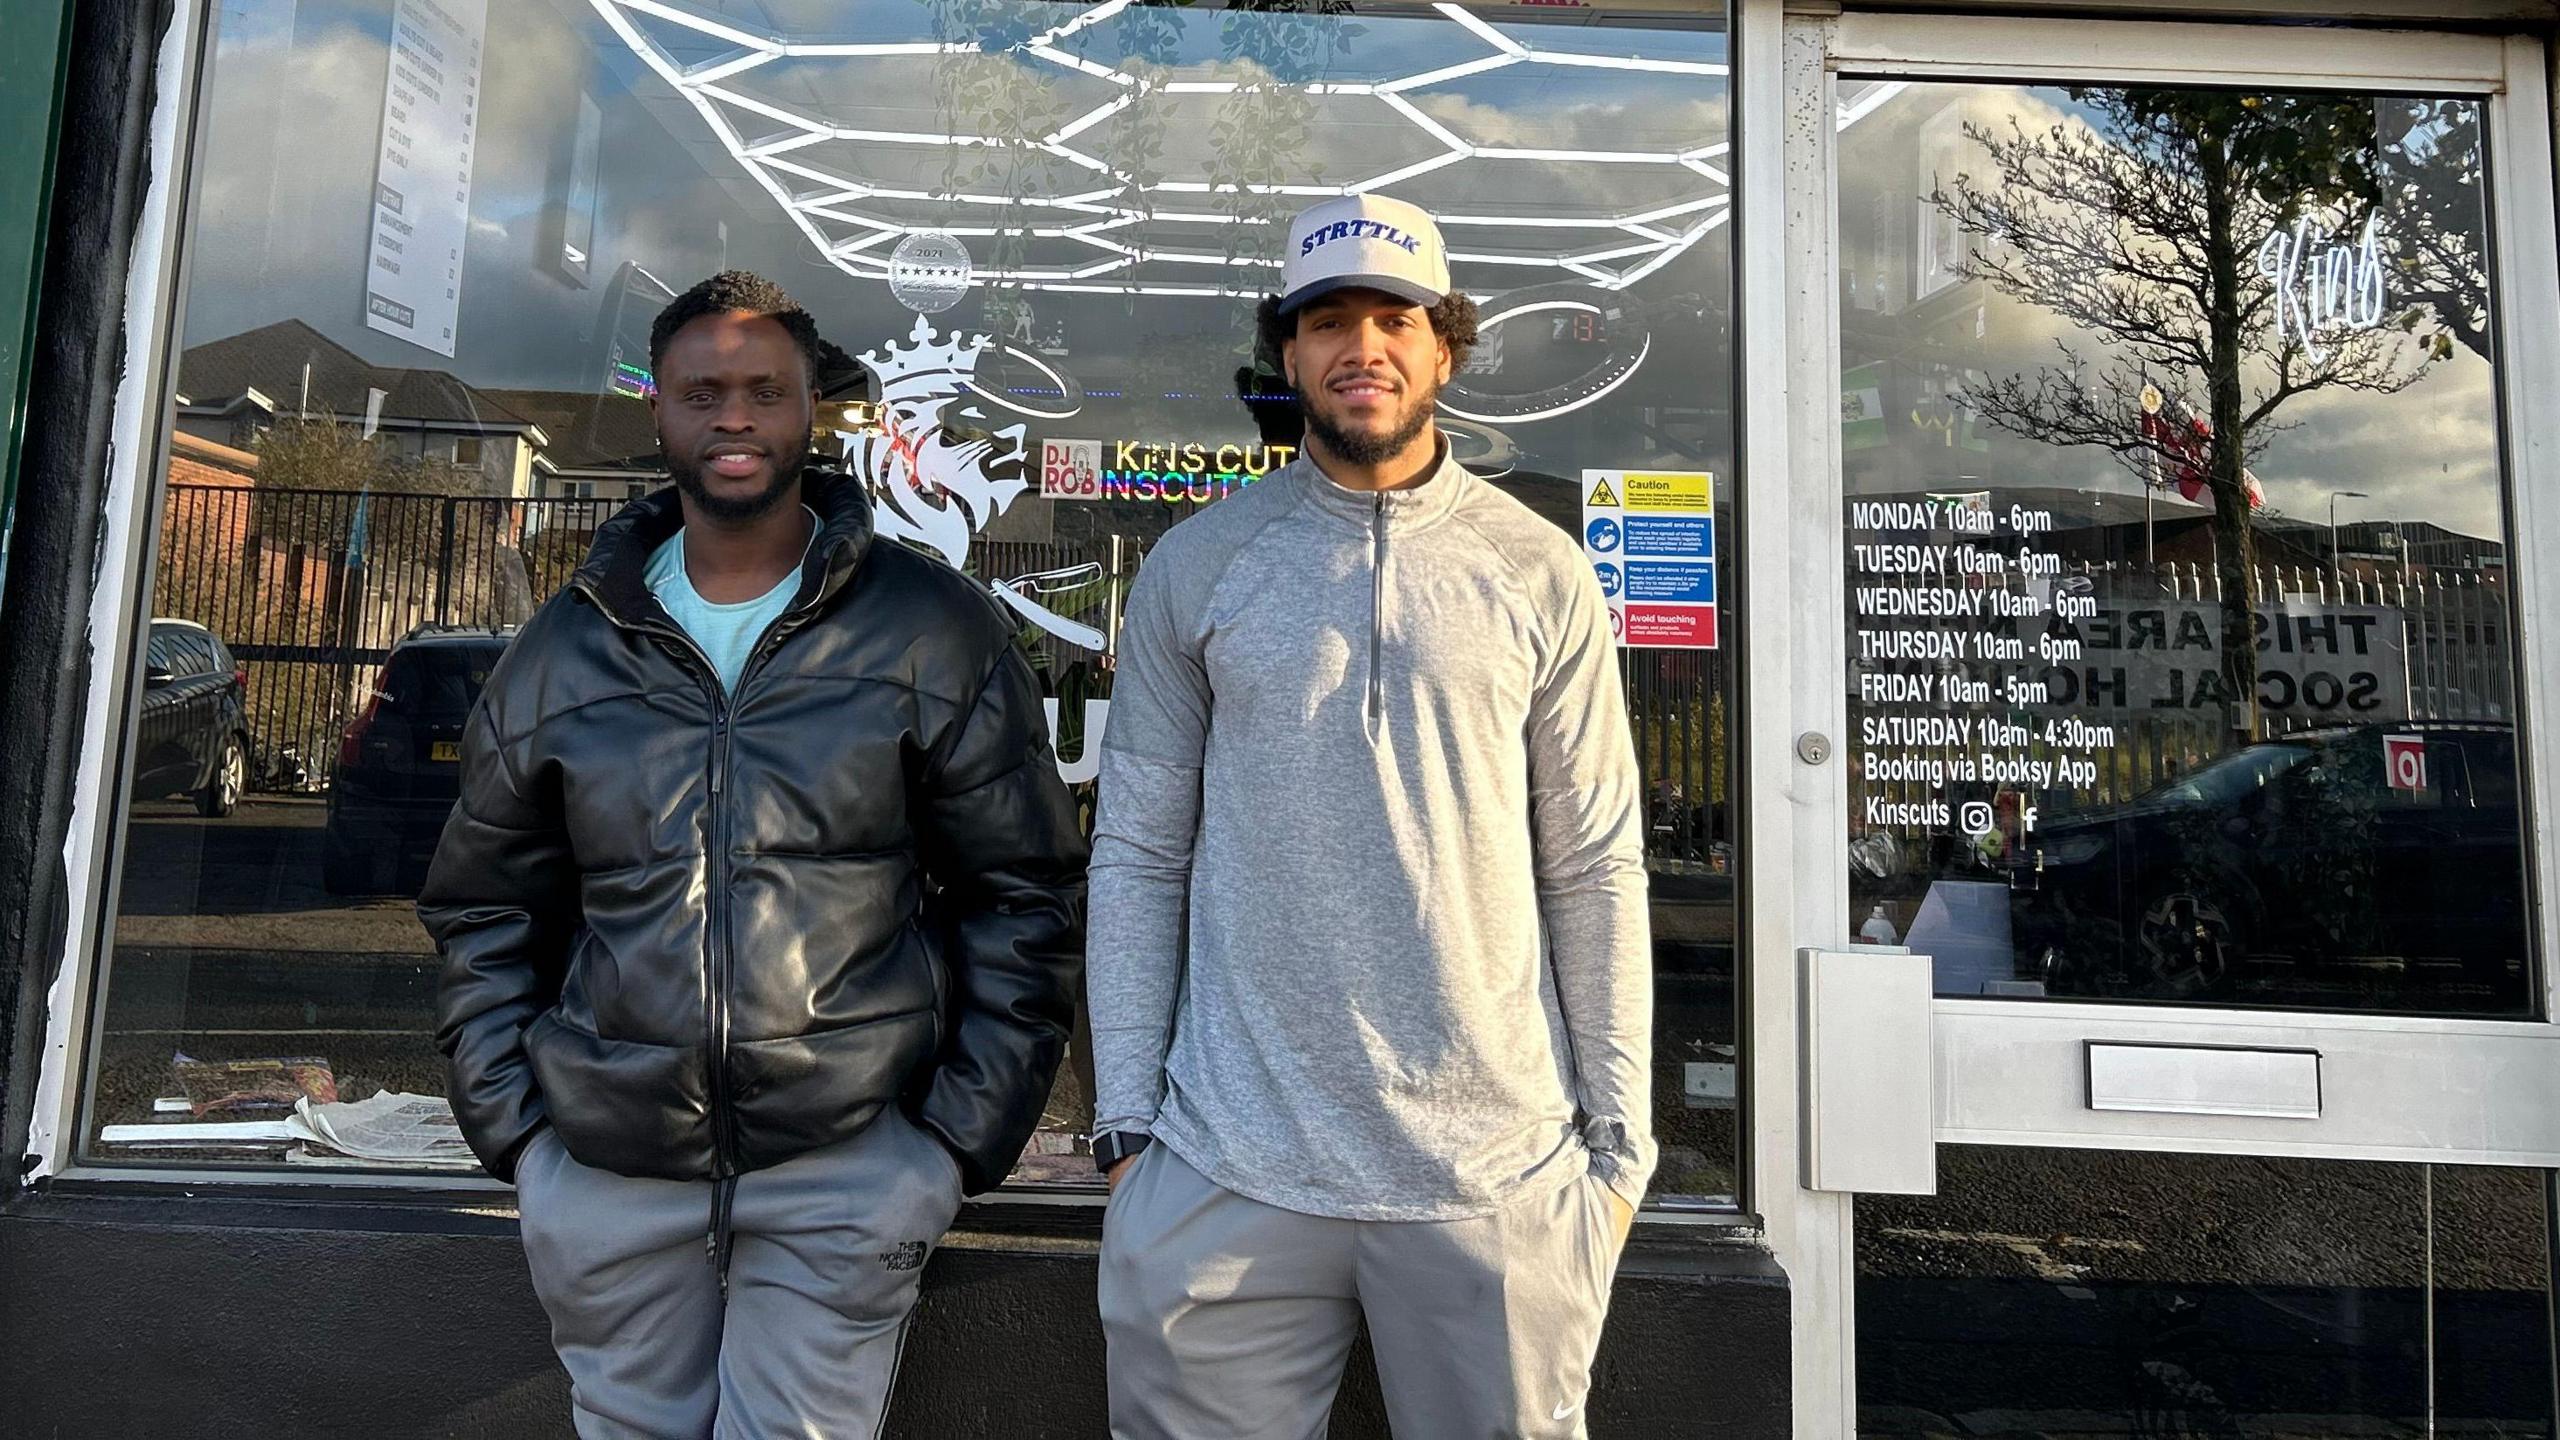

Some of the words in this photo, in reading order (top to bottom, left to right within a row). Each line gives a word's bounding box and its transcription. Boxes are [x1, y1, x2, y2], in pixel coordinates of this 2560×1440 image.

[916, 249, 943, 258] 2021
[1046, 445, 1070, 465] DJ
[1045, 467, 1095, 494] ROB
[1628, 480, 1670, 490] Caution
[1853, 503, 1938, 530] MONDAY
[1945, 505, 1994, 531] 10am
[2011, 504, 2051, 539] 6pm
[1854, 545, 1947, 573] TUESDAY
[1954, 546, 2003, 573] 10am
[2020, 549, 2060, 580] 6pm
[1630, 614, 1656, 623] Avoid
[1657, 615, 1696, 626] touching
[1856, 588, 1984, 616] WEDNESDAY
[1990, 589, 2038, 616] 10am
[2056, 591, 2096, 623] 6pm
[1858, 631, 1967, 659] THURSDAY
[1974, 632, 2022, 659] 10am
[2040, 634, 2080, 666] 6pm
[1861, 674, 1934, 702] FRIDAY
[1940, 675, 1989, 702] 10am
[2007, 676, 2048, 709] 5pm
[1863, 717, 1970, 746] SATURDAY
[1978, 718, 2028, 746] 10am
[2045, 720, 2114, 753] 4:30pm
[1864, 752, 1943, 787] Booking
[1948, 757, 1976, 782] via
[1982, 754, 2052, 788] Booksy
[2058, 755, 2096, 792] App
[1866, 795, 1950, 826] Kinscuts
[879, 1252, 915, 1262] NORTH
[898, 1242, 918, 1252] THE
[886, 1262, 914, 1271] FACE
